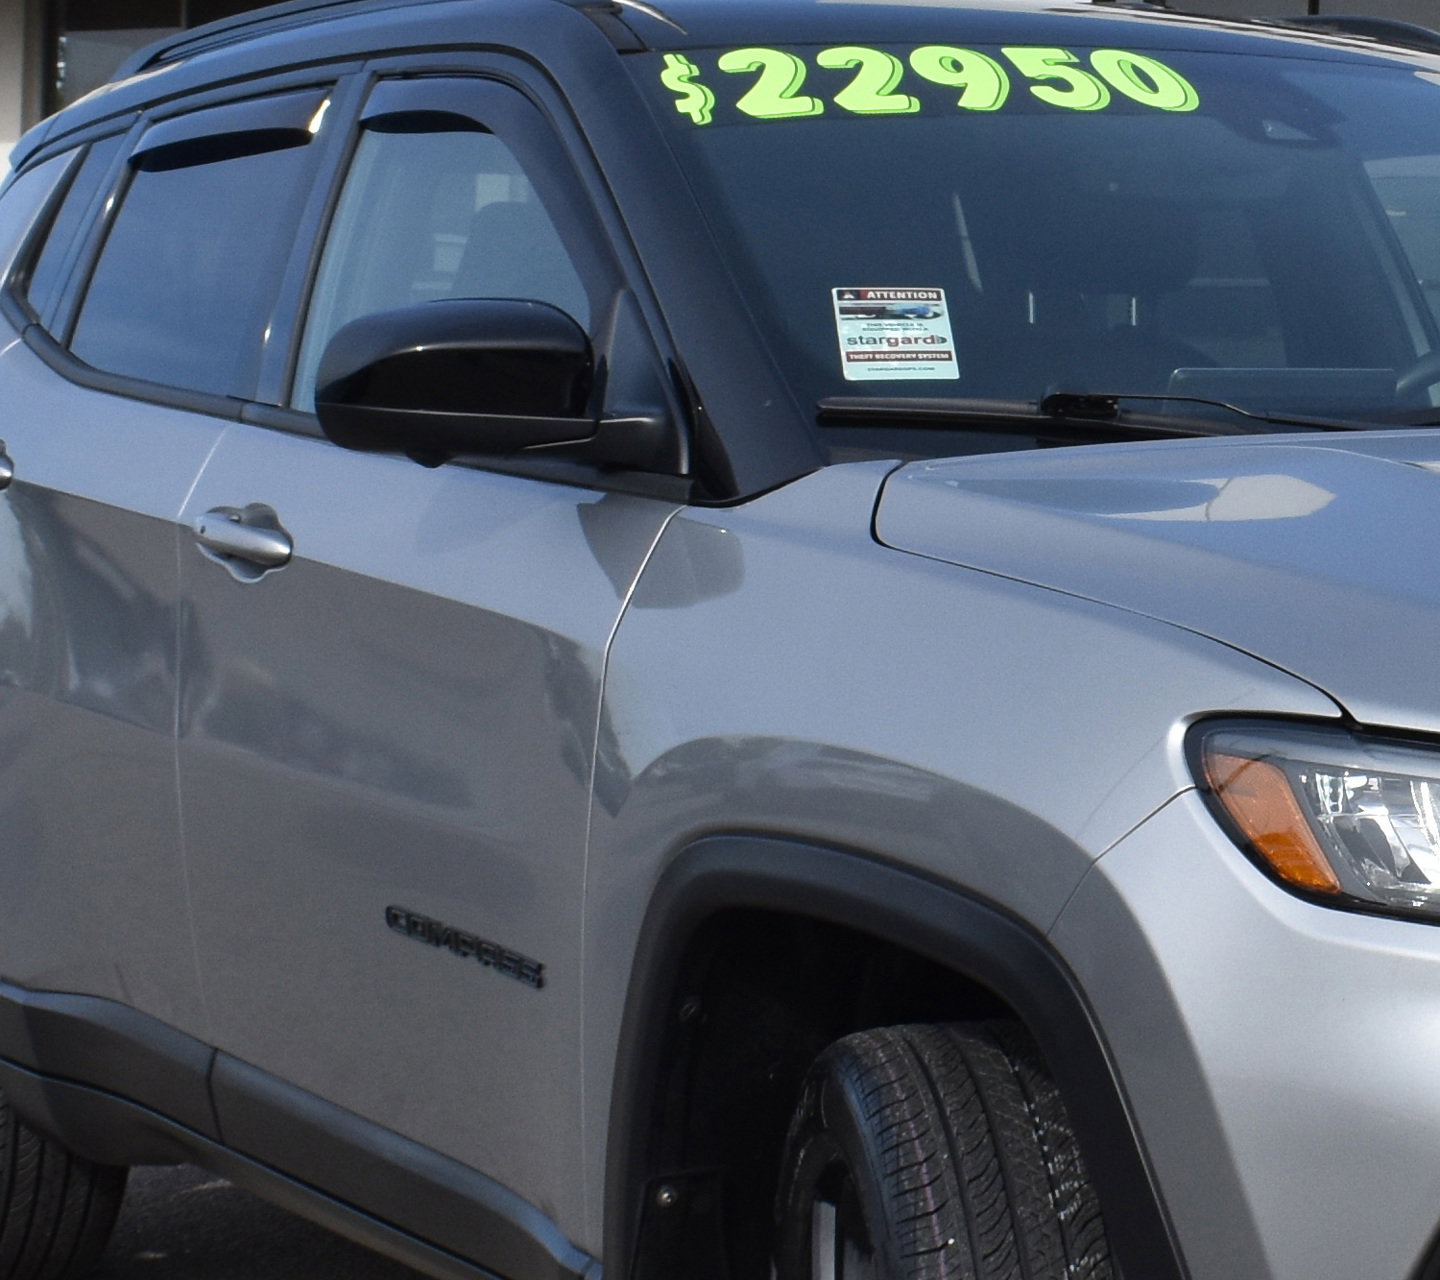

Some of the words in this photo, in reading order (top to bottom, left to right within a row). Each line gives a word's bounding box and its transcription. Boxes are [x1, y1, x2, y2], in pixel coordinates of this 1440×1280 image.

[660, 45, 1200, 126] $22950
[866, 291, 938, 299] ATTENTION
[847, 335, 936, 347] stargard
[848, 353, 874, 361] THEFT
